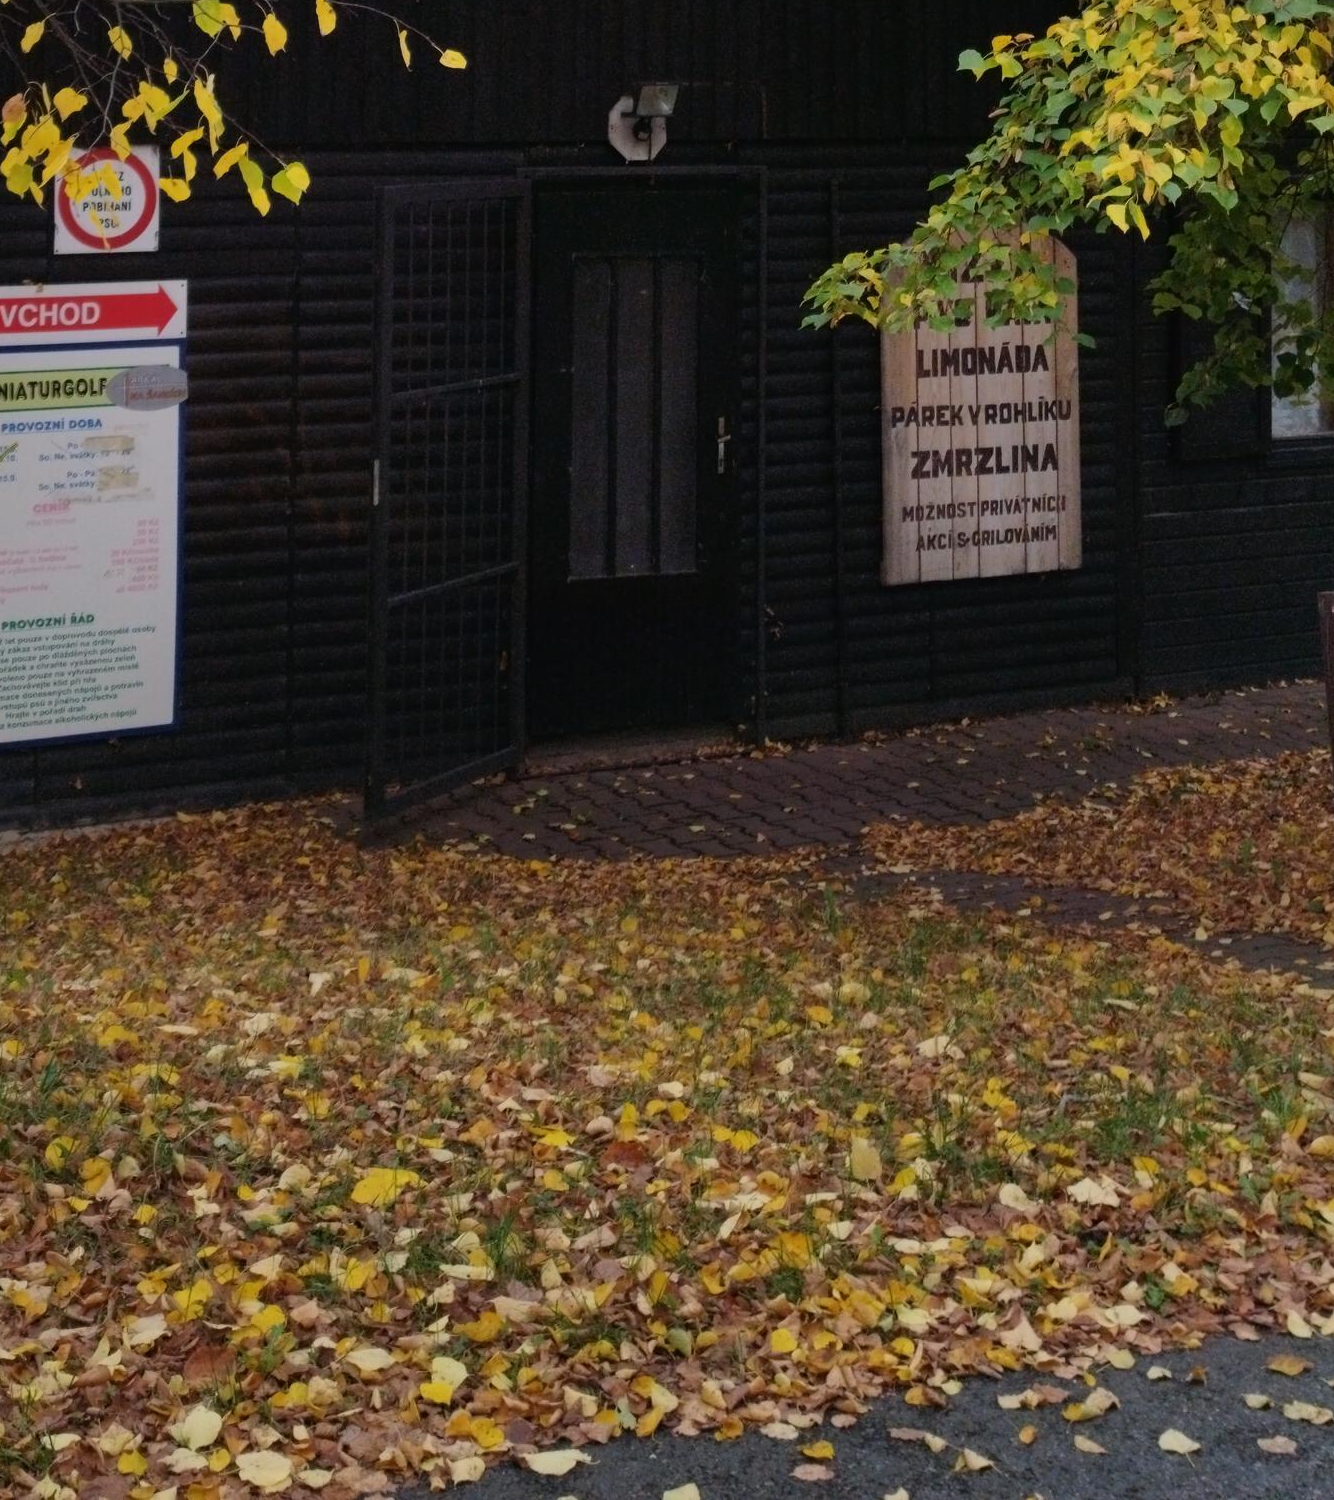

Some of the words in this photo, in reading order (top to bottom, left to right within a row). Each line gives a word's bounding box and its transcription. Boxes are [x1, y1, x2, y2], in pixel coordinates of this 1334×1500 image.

[917, 342, 1049, 378] LIMONÁDA
[1, 418, 66, 433] PROVOZNÍ
[69, 418, 103, 429] DOBA
[891, 402, 963, 428] PÁREK
[968, 405, 981, 426] V
[985, 396, 1072, 425] ROHLÍKU
[911, 443, 1058, 479] ZMRZLINA
[902, 501, 977, 523] MOŽNOST
[980, 493, 1066, 516] PRIVÁTNÍCH
[916, 527, 952, 551] AKCÍ
[972, 521, 1057, 546] GRILOVÁNÍM
[1, 614, 66, 631] PROVOZNÍ
[71, 612, 95, 625] ŘÁD
[131, 625, 156, 634] osoby
